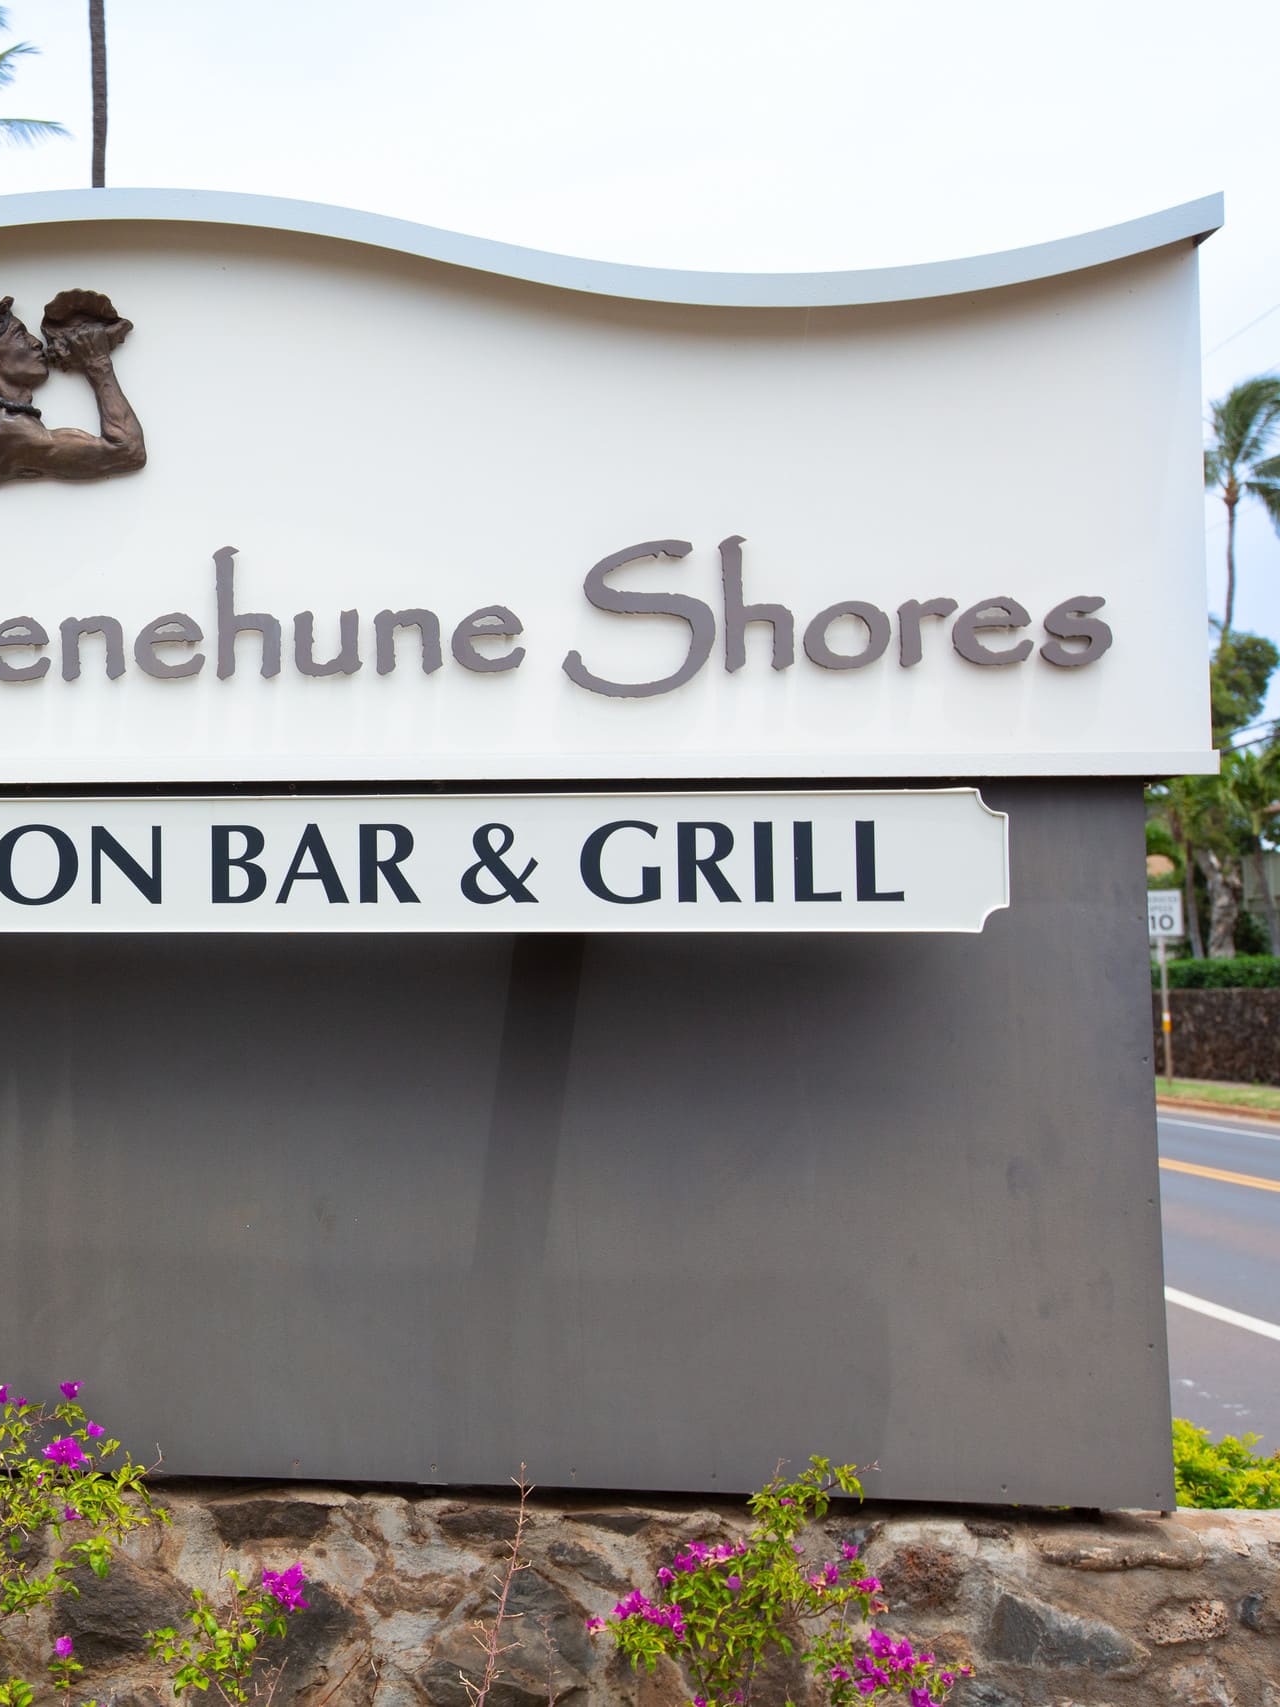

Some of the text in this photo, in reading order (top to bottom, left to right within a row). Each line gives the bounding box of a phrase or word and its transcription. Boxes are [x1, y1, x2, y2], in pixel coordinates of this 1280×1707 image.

[562, 535, 1113, 698] Shores
[211, 823, 421, 904] BAR
[460, 822, 540, 905] &
[579, 820, 905, 905] GRILL
